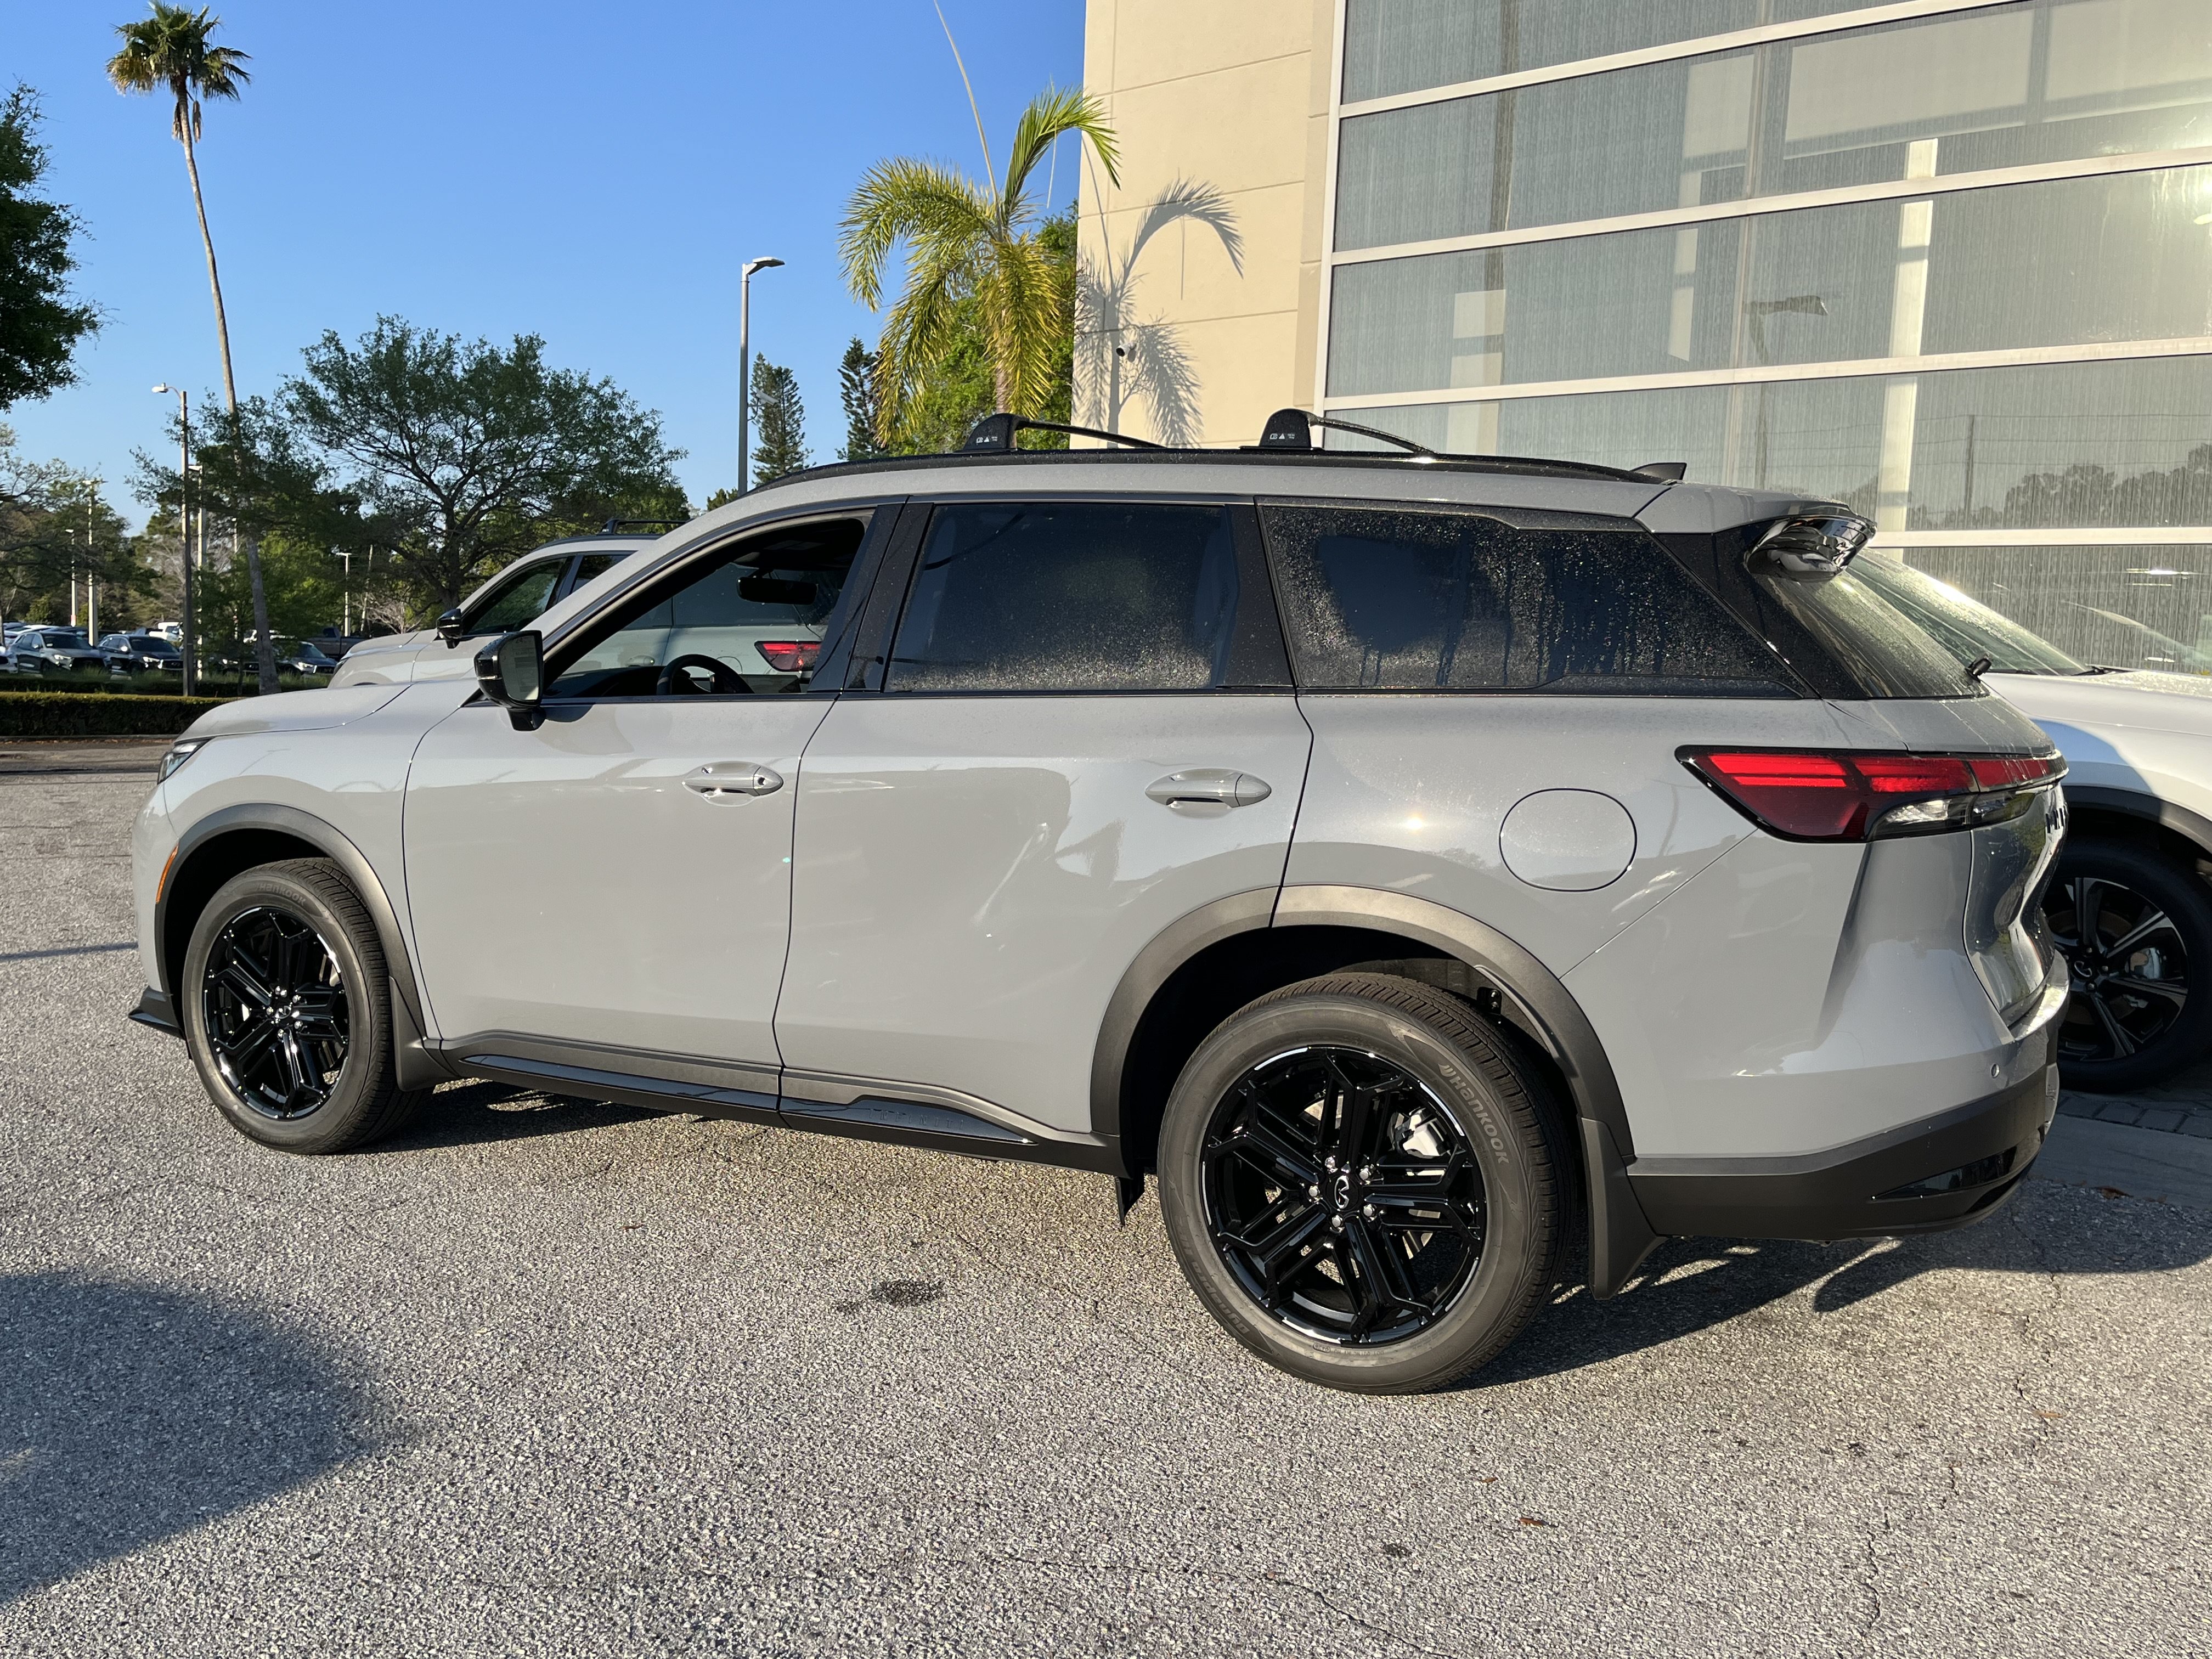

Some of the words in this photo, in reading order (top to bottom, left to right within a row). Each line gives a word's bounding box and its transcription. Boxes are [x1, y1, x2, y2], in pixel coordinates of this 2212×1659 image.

[868, 1108, 964, 1131] INFINITI
[1448, 1075, 1510, 1164] Hankook
[1192, 1261, 1250, 1334] Dynapro
